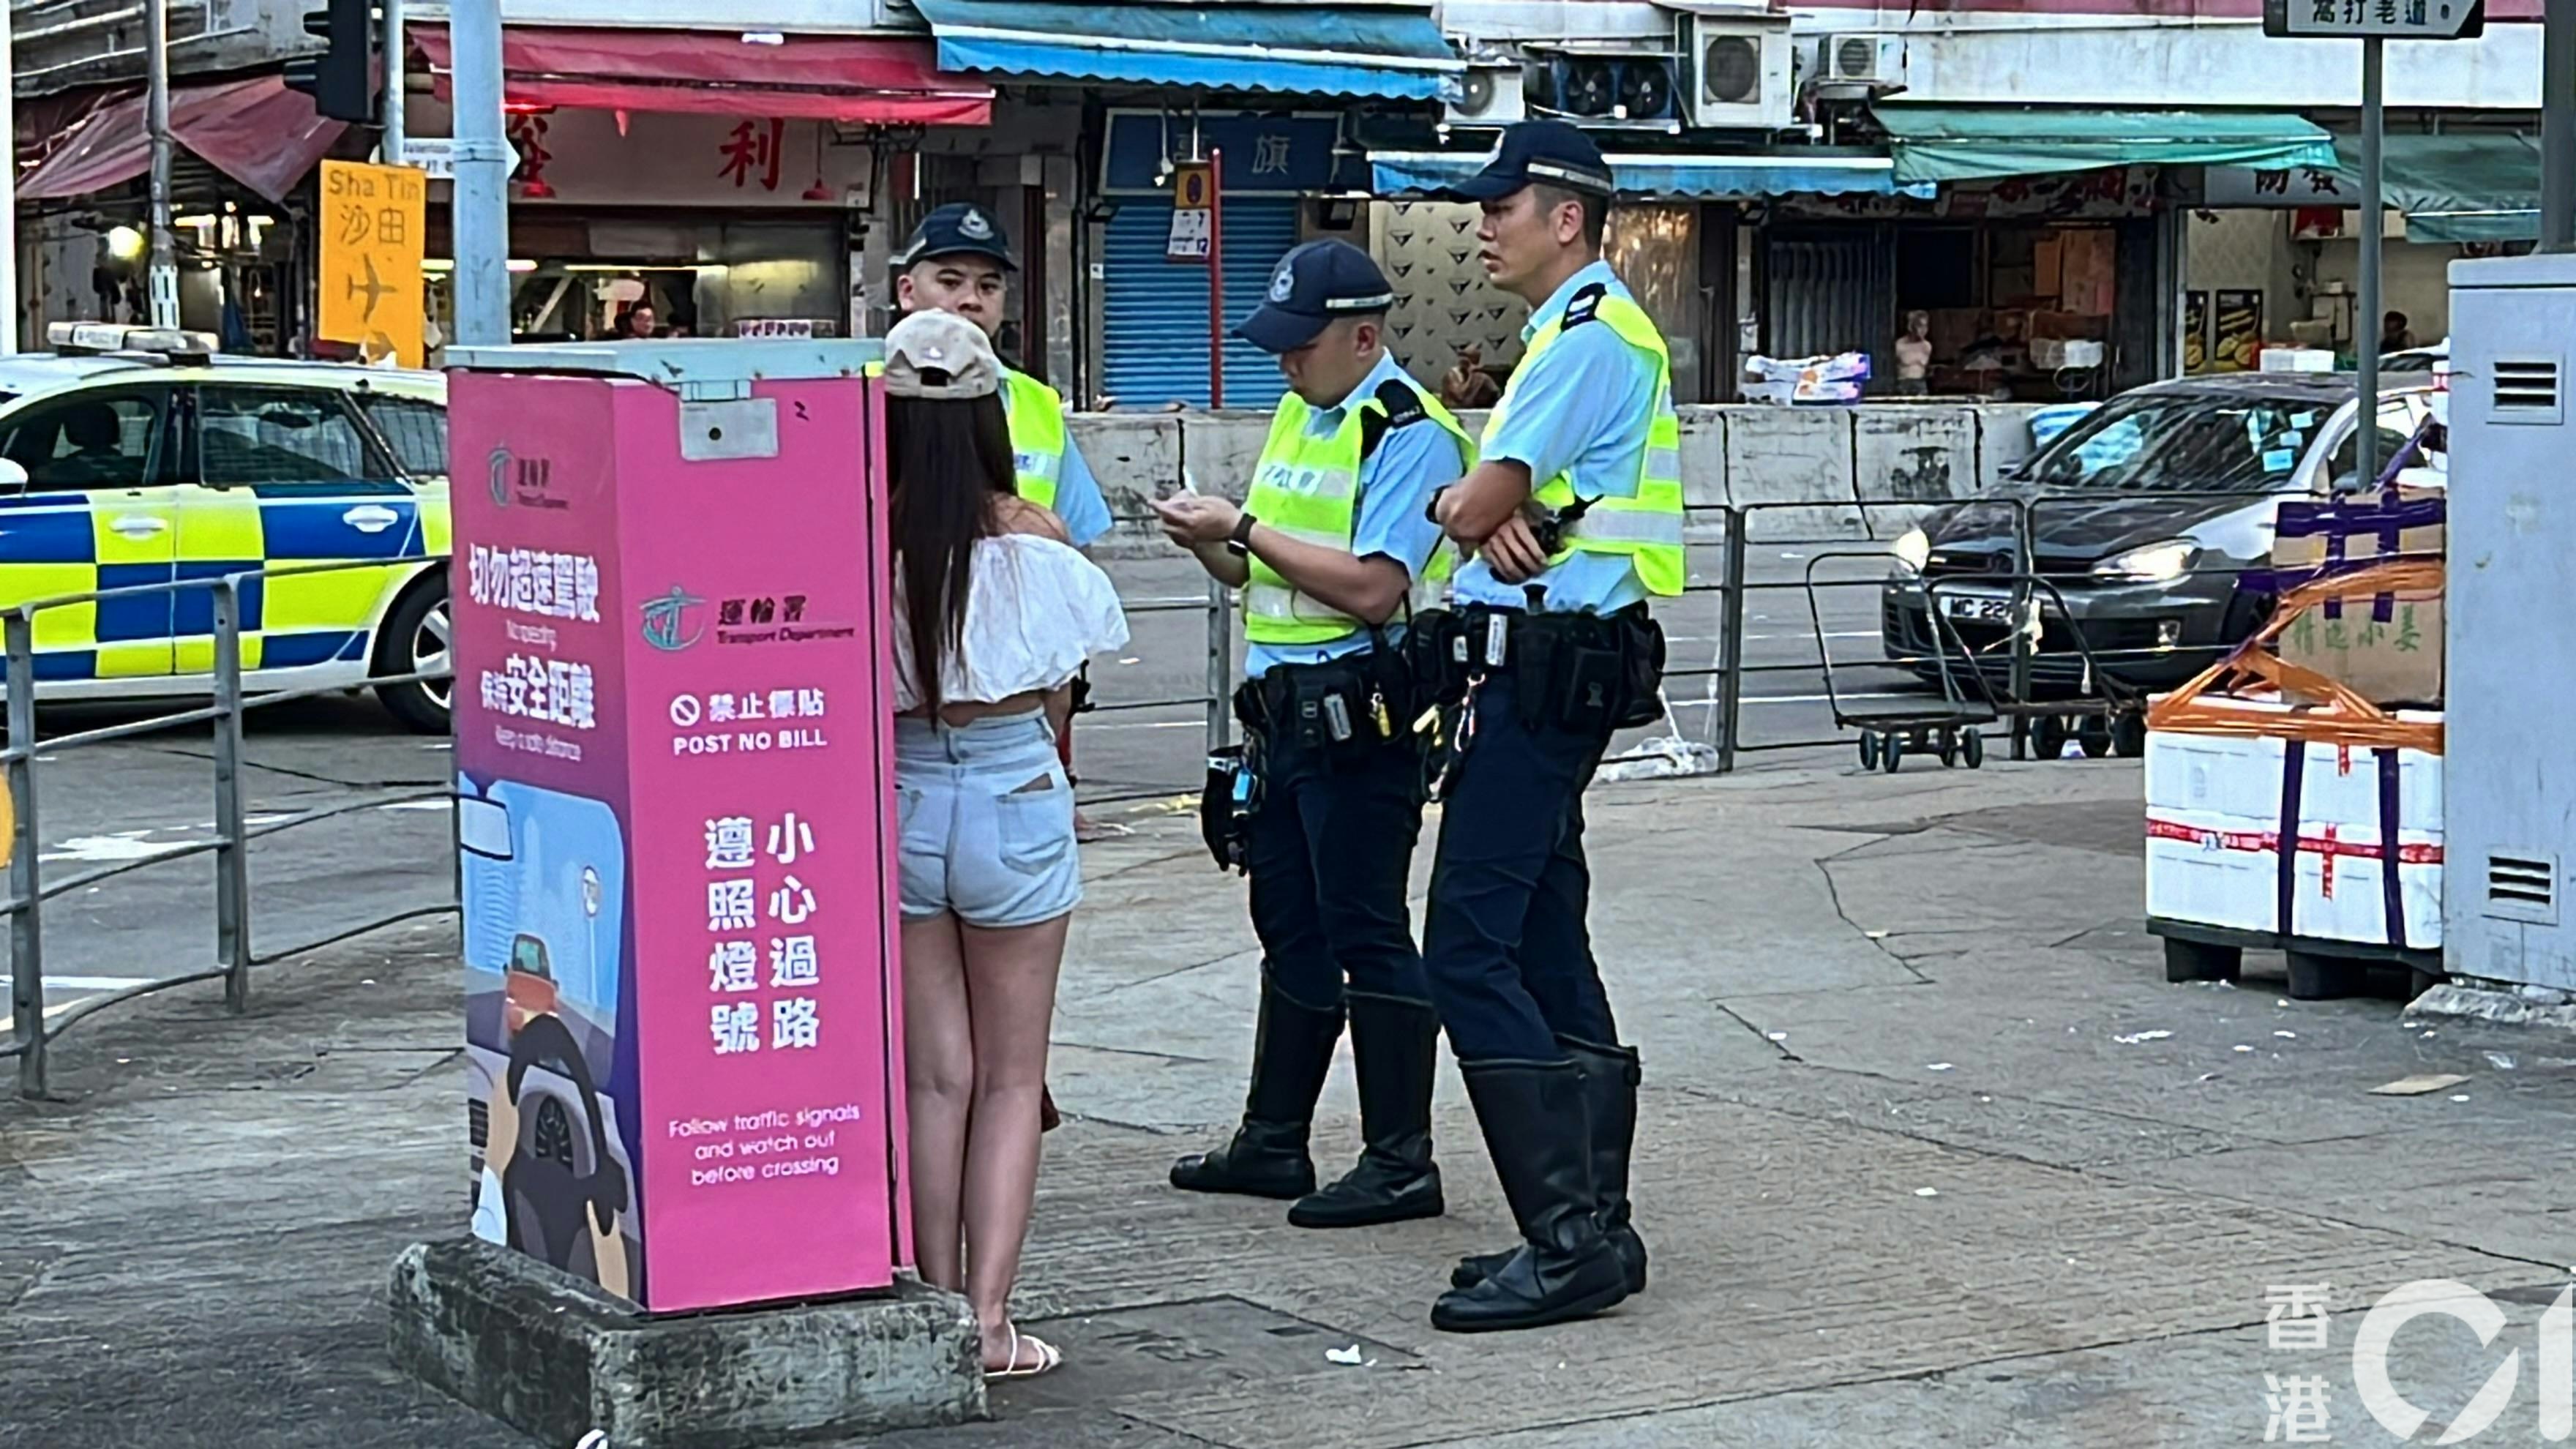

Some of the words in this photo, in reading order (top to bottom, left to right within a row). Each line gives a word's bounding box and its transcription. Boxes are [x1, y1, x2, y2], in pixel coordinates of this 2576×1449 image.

[329, 169, 374, 197] Sha
[385, 173, 420, 201] Tin
[340, 204, 405, 246] 沙田
[469, 542, 599, 623] 切勿超速駕駛
[708, 688, 825, 722] 禁止標貼
[673, 734, 732, 755] POST
[738, 732, 771, 751] NO
[779, 729, 828, 748] BILL
[705, 817, 760, 1055] 遵照燈號
[766, 812, 820, 1050] 小心過路
[669, 1119, 727, 1138] Follow
[734, 1111, 789, 1131] traffic
[796, 1104, 860, 1128] signals
[695, 1141, 733, 1160] and
[739, 1134, 798, 1156] watch
[804, 1130, 835, 1147] out
[692, 1164, 755, 1186] before
[762, 1157, 839, 1178] crossing
